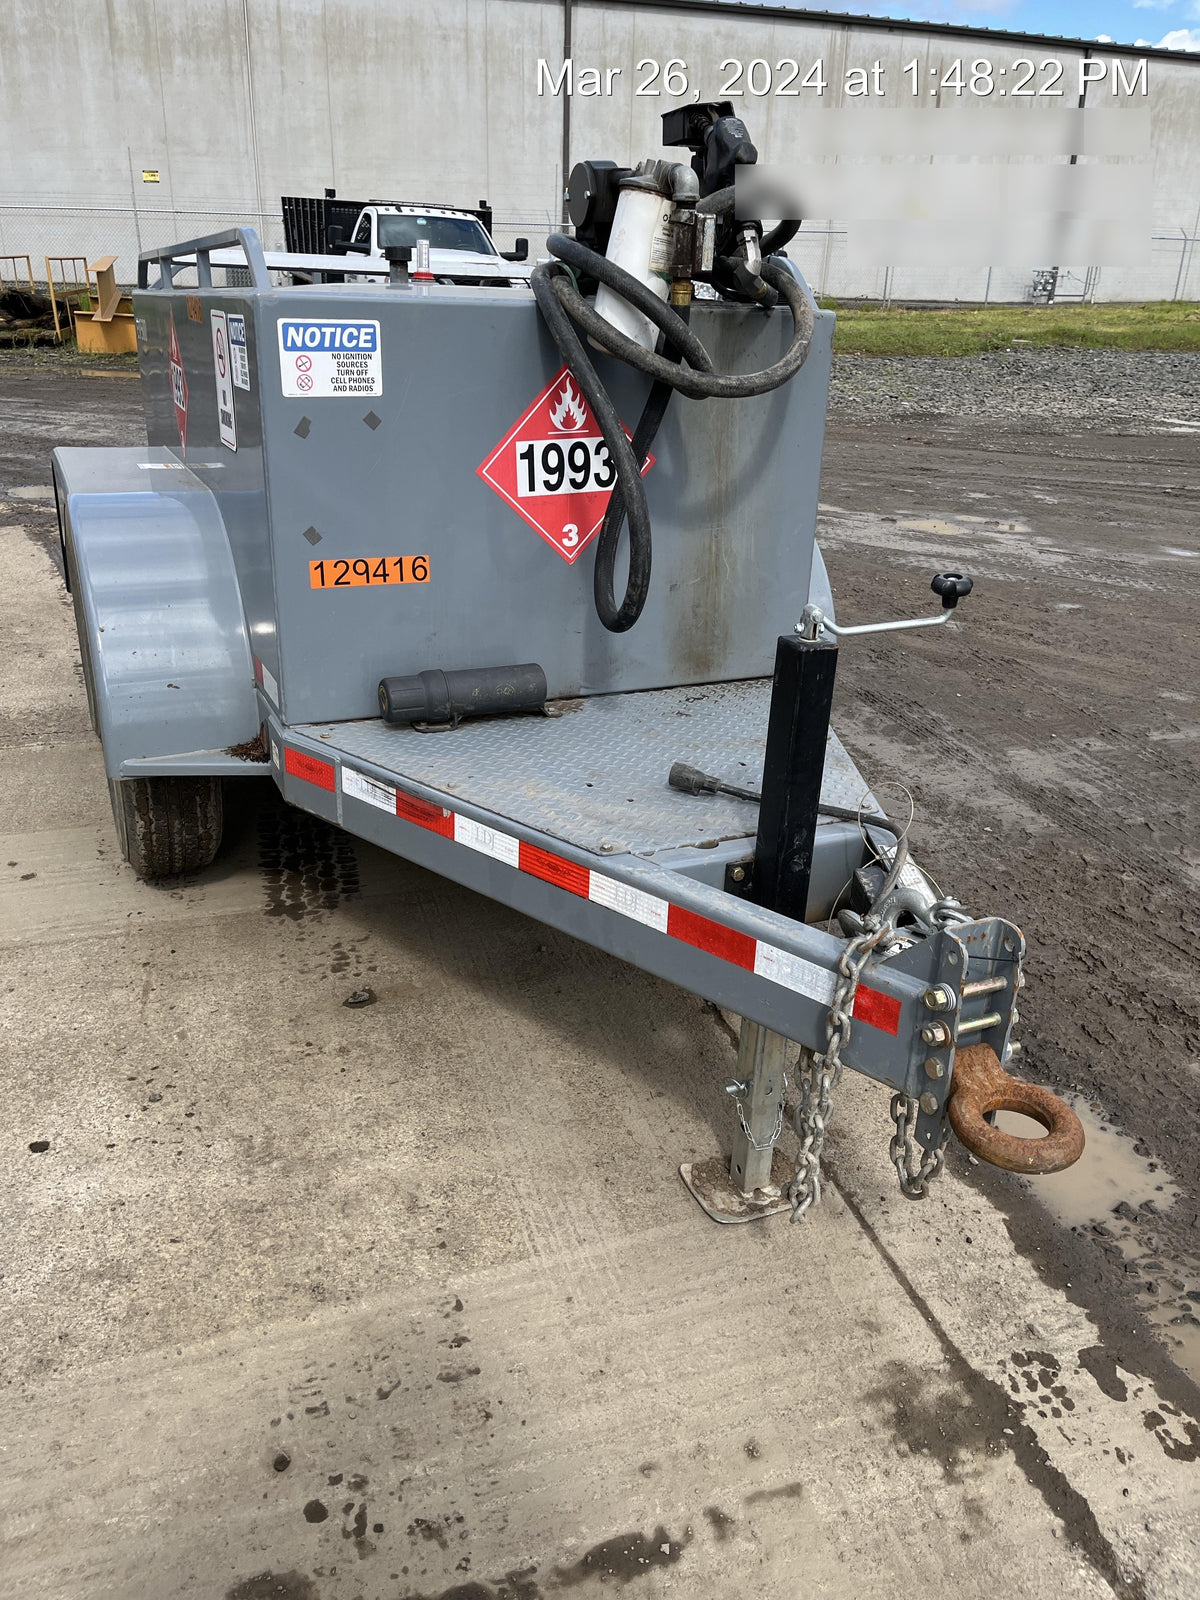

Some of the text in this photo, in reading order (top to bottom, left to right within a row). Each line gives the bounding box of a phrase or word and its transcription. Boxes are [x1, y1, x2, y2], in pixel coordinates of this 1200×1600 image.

[286, 326, 374, 348] NOTICE
[519, 440, 616, 493] 1993
[562, 523, 579, 547] 3
[314, 556, 428, 587] 129416
